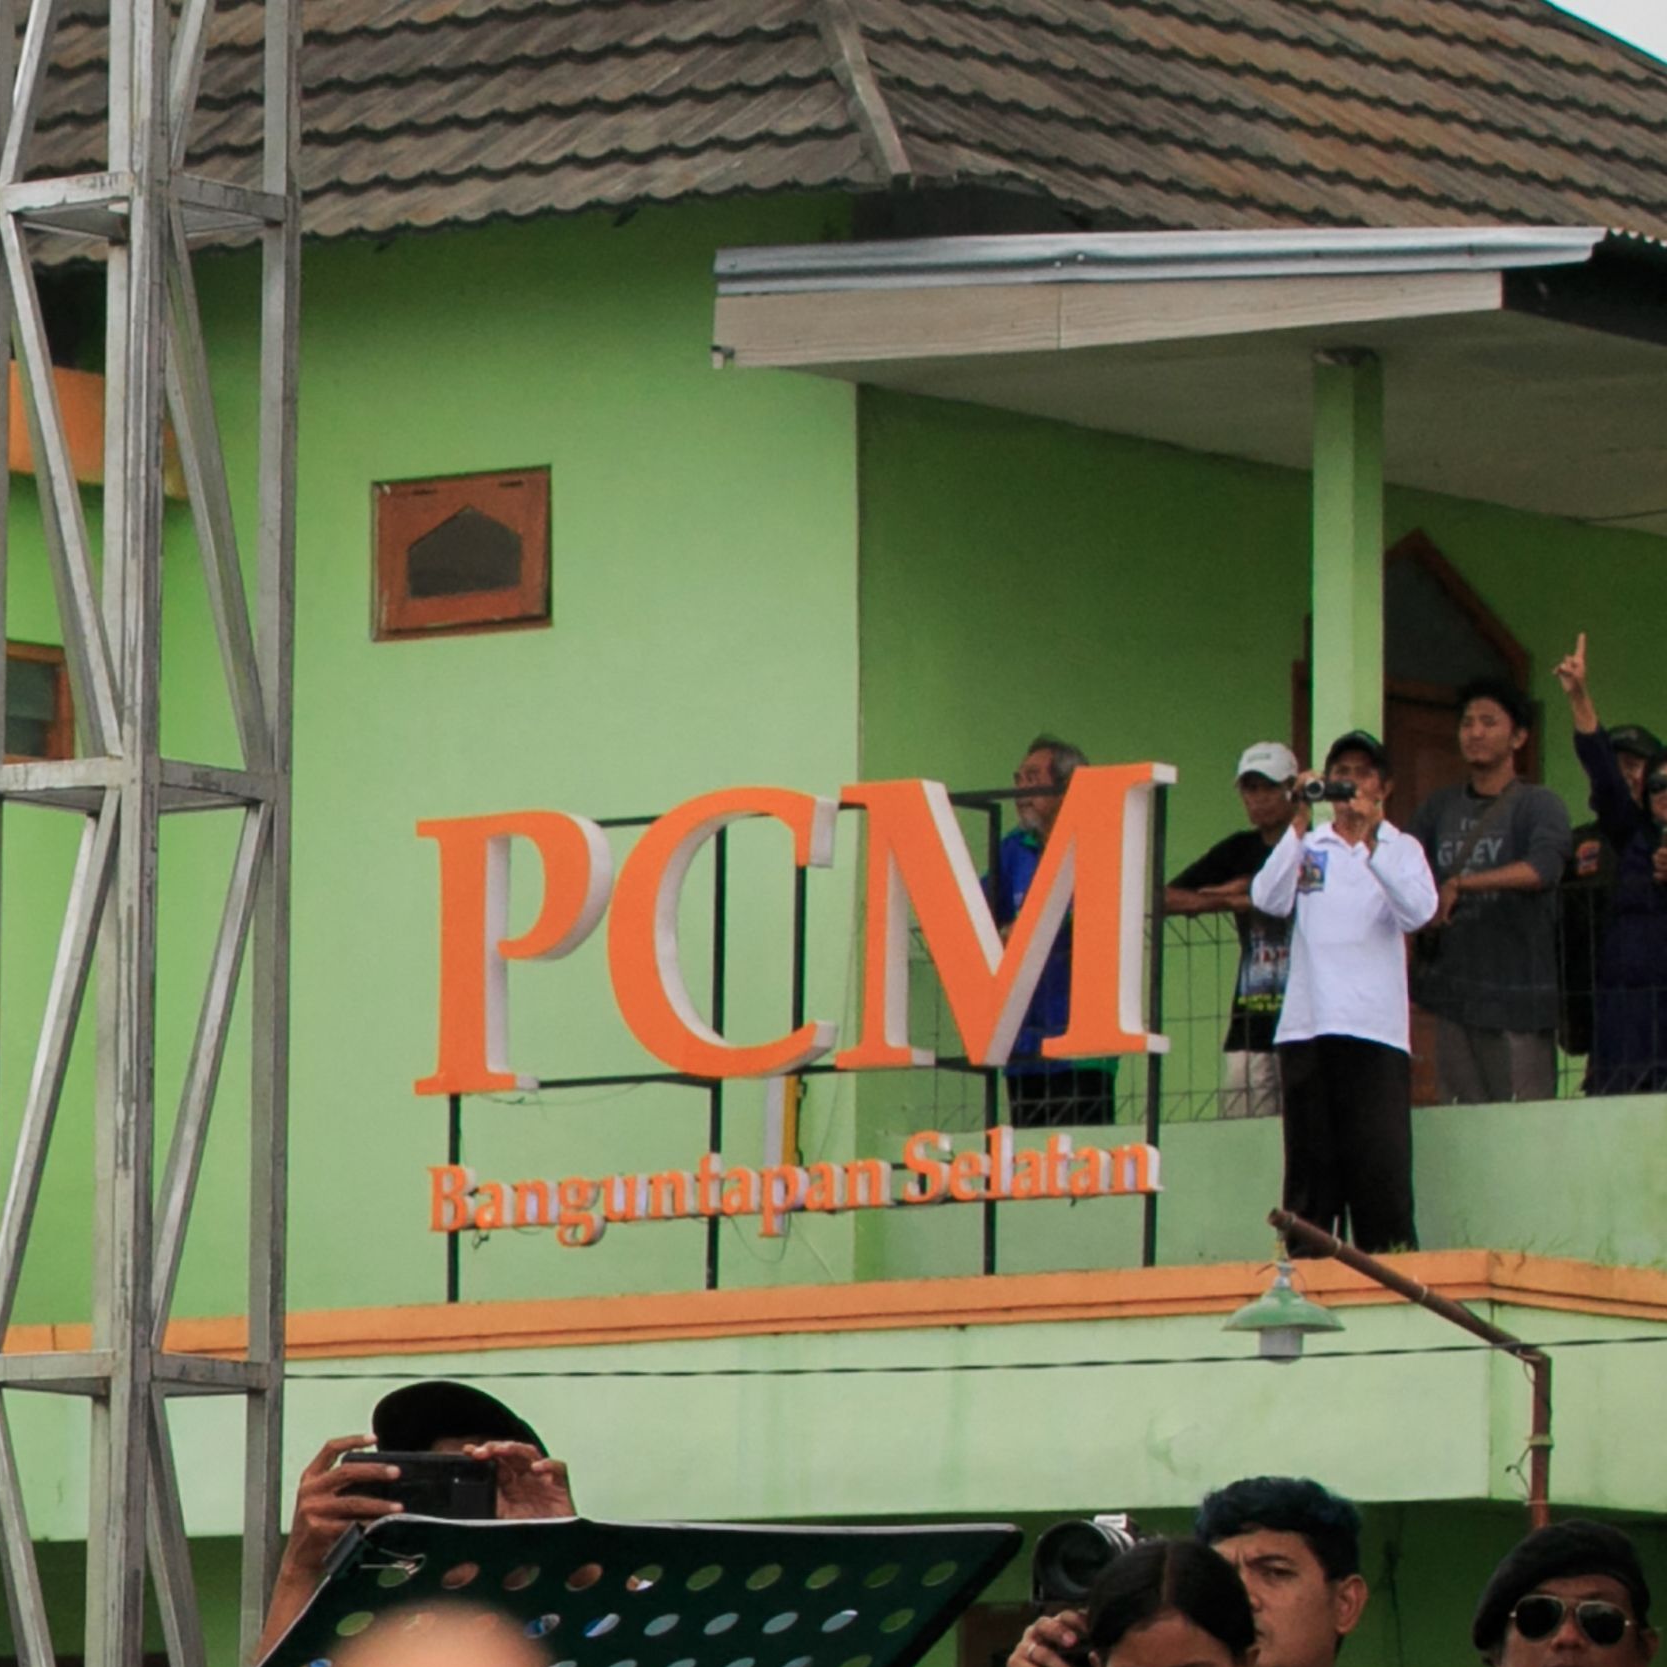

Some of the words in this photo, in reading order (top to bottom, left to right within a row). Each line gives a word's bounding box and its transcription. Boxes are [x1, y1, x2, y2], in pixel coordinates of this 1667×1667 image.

[415, 762, 1178, 1096] PCM
[428, 1150, 892, 1247] Banguntapan
[903, 1125, 1162, 1203] Selatan
